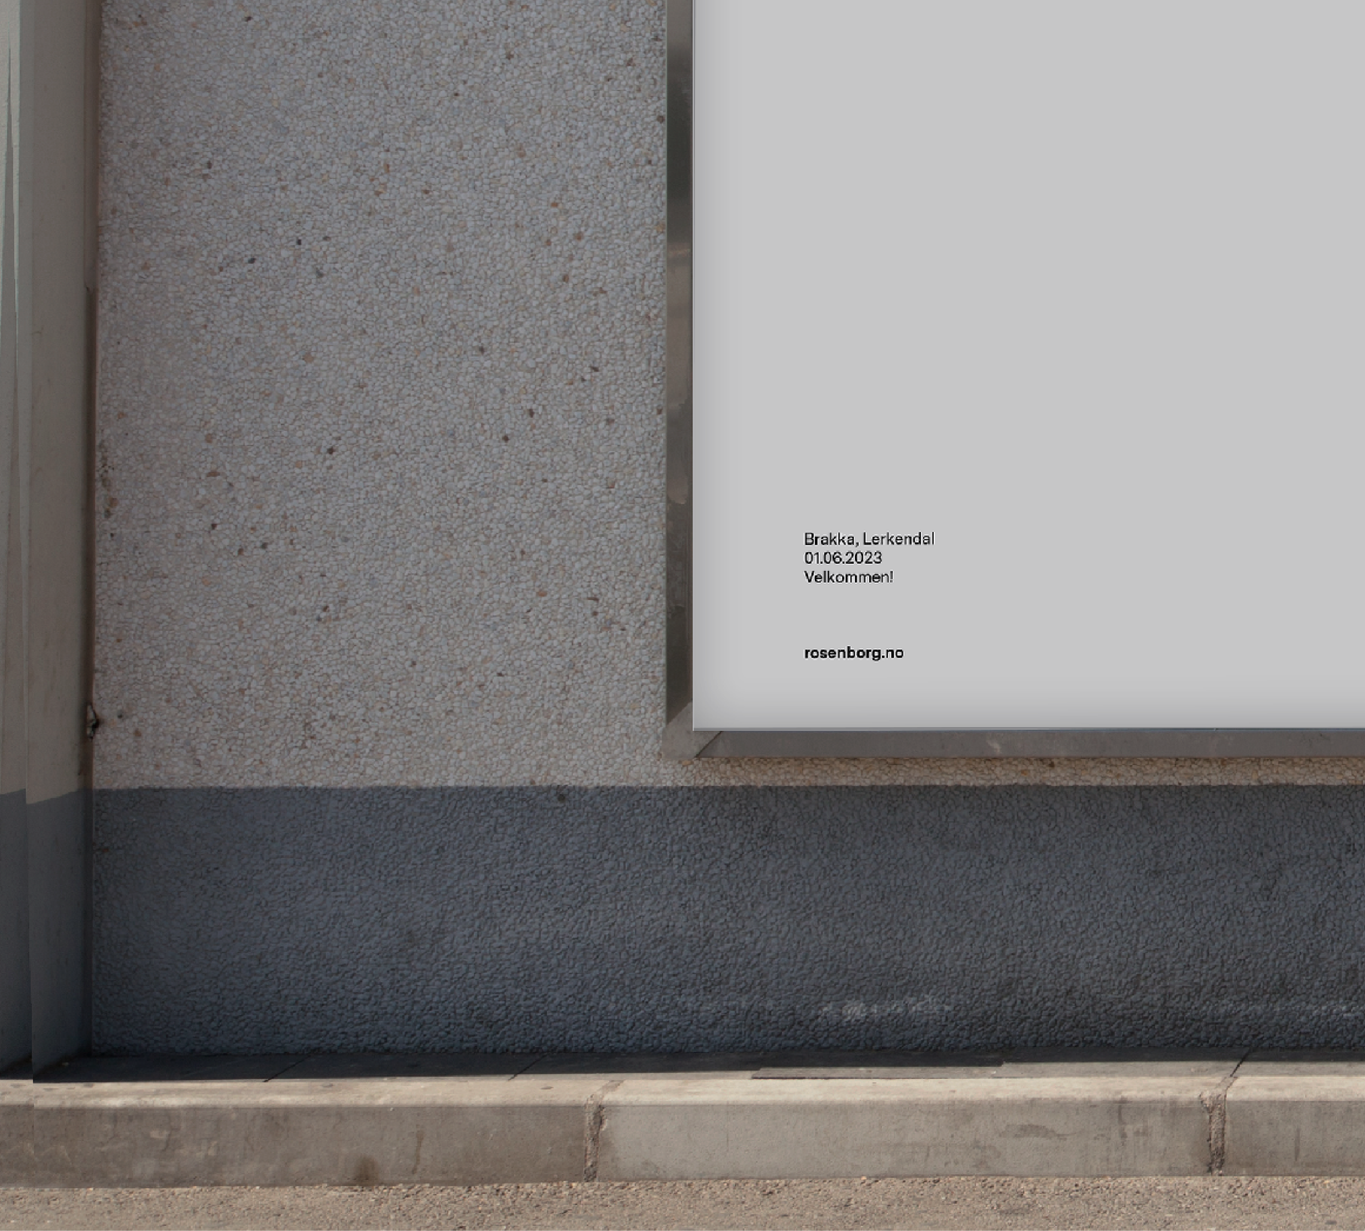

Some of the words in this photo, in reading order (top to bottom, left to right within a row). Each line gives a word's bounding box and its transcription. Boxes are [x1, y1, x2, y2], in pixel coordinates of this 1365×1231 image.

[805, 532, 859, 547] Brakka,
[863, 532, 934, 545] Lerkendal
[805, 551, 882, 564] 01.06.2023
[804, 570, 893, 583] Velkommen!
[805, 646, 903, 661] rosenborg.no
